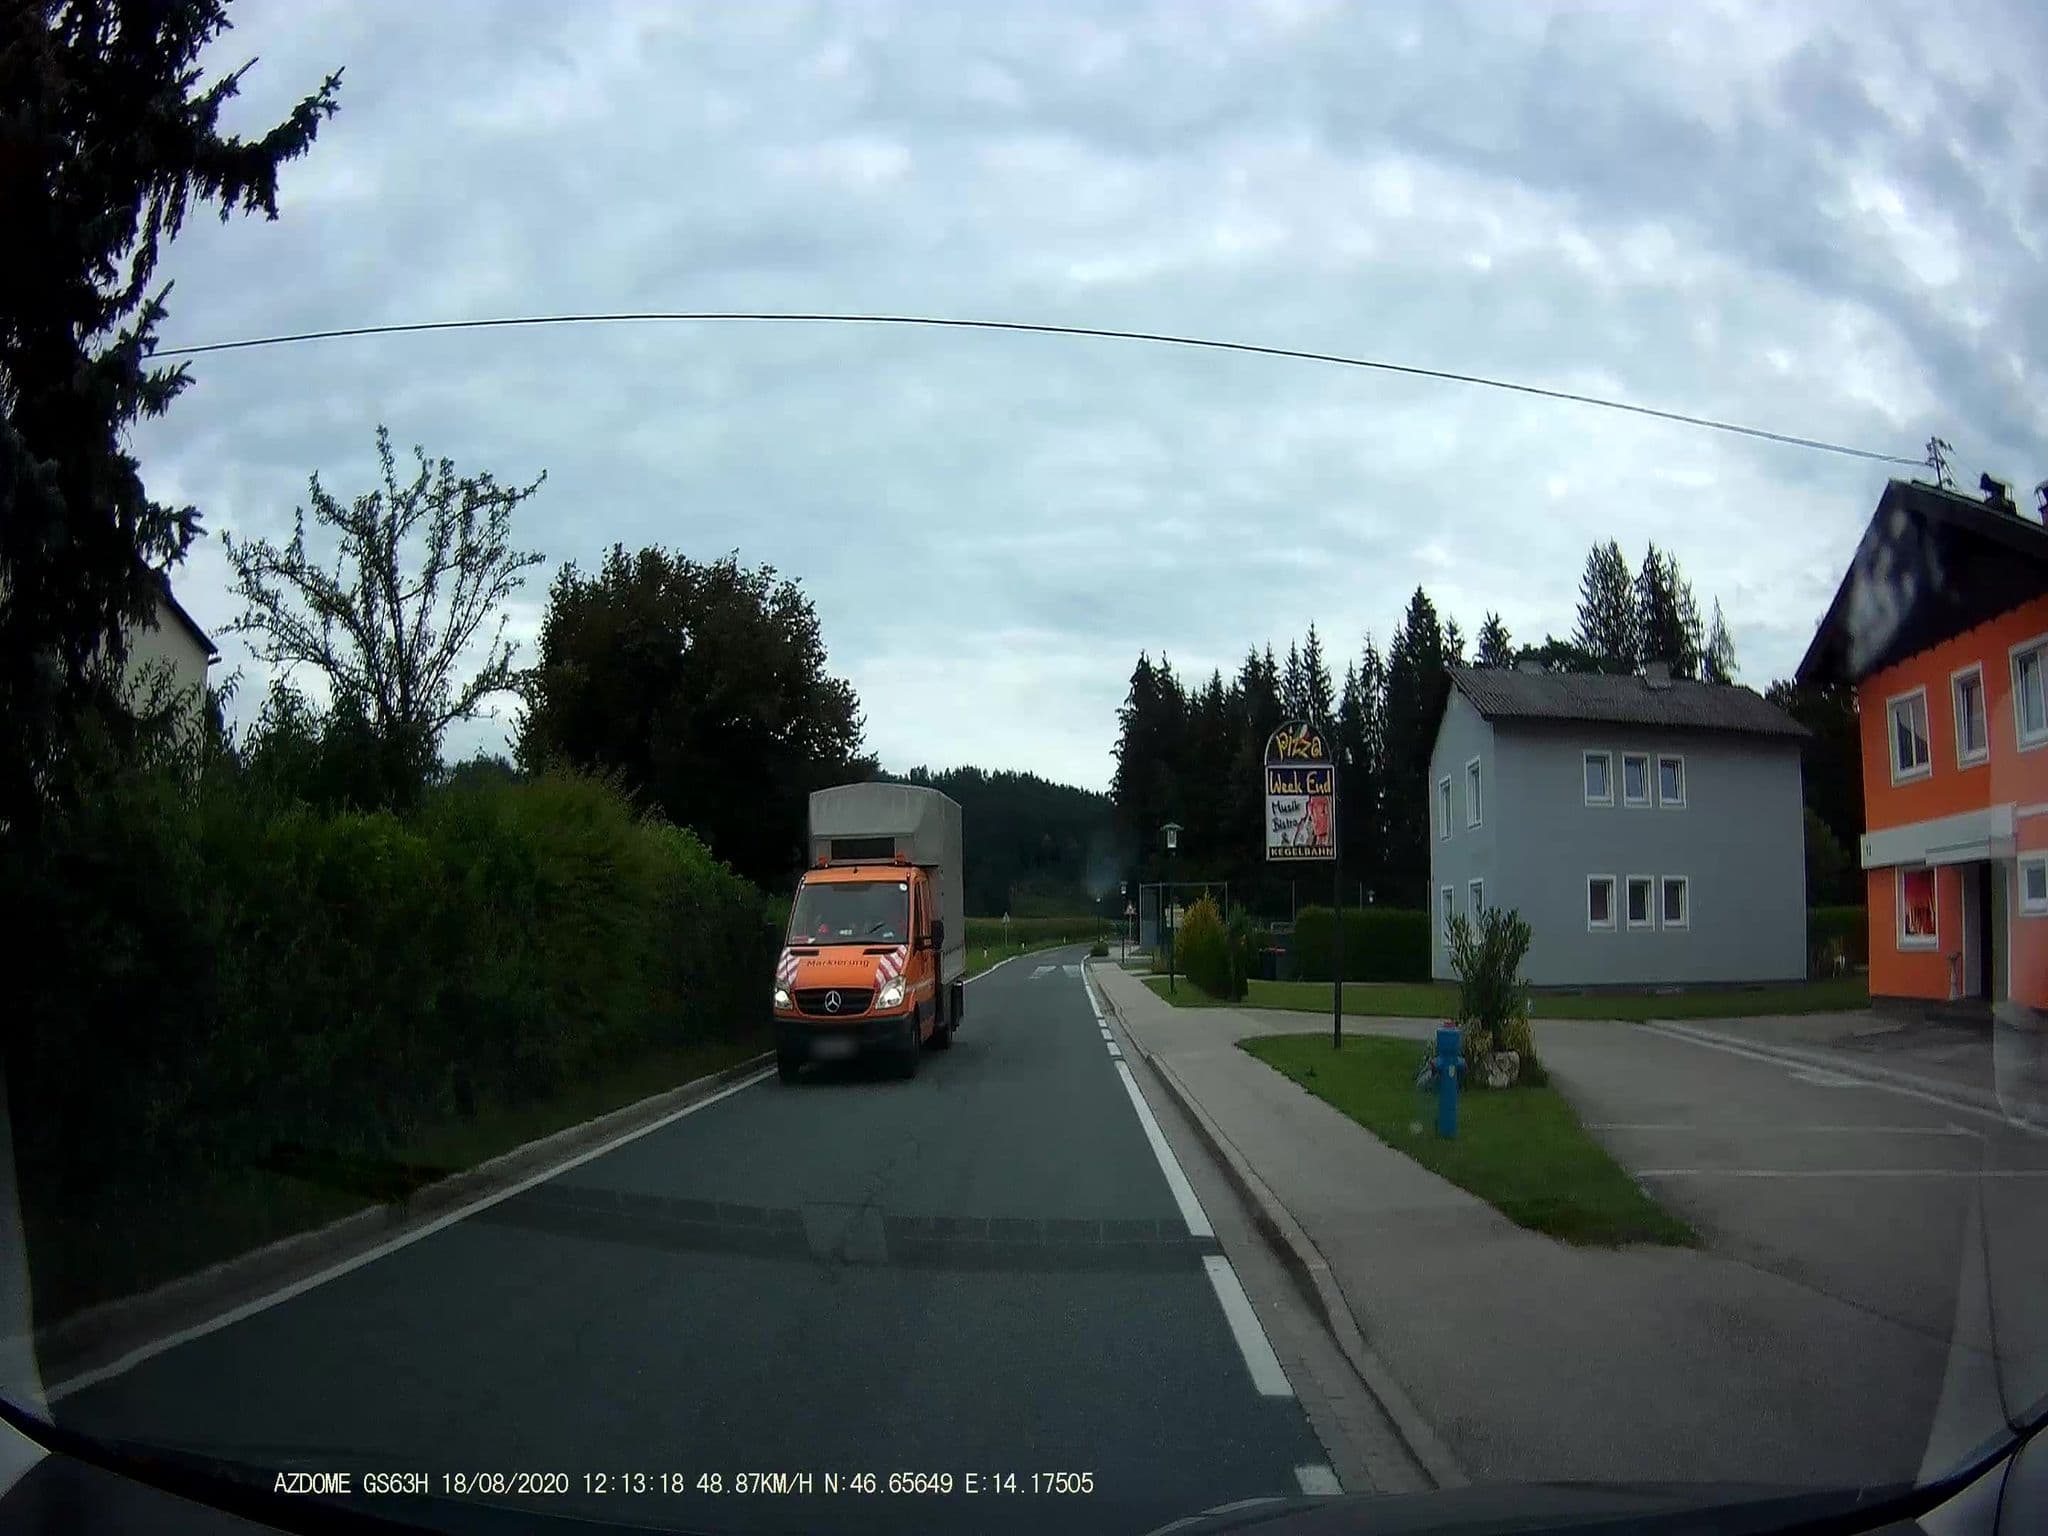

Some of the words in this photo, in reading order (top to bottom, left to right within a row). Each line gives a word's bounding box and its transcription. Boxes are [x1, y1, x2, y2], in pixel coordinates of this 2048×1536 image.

[1276, 726, 1322, 762] Pizza
[1270, 770, 1302, 793] Week
[1307, 770, 1331, 794] End
[1272, 800, 1300, 815] Musik
[1272, 817, 1298, 832] Bistro
[1271, 847, 1333, 857] KEGELBAHN
